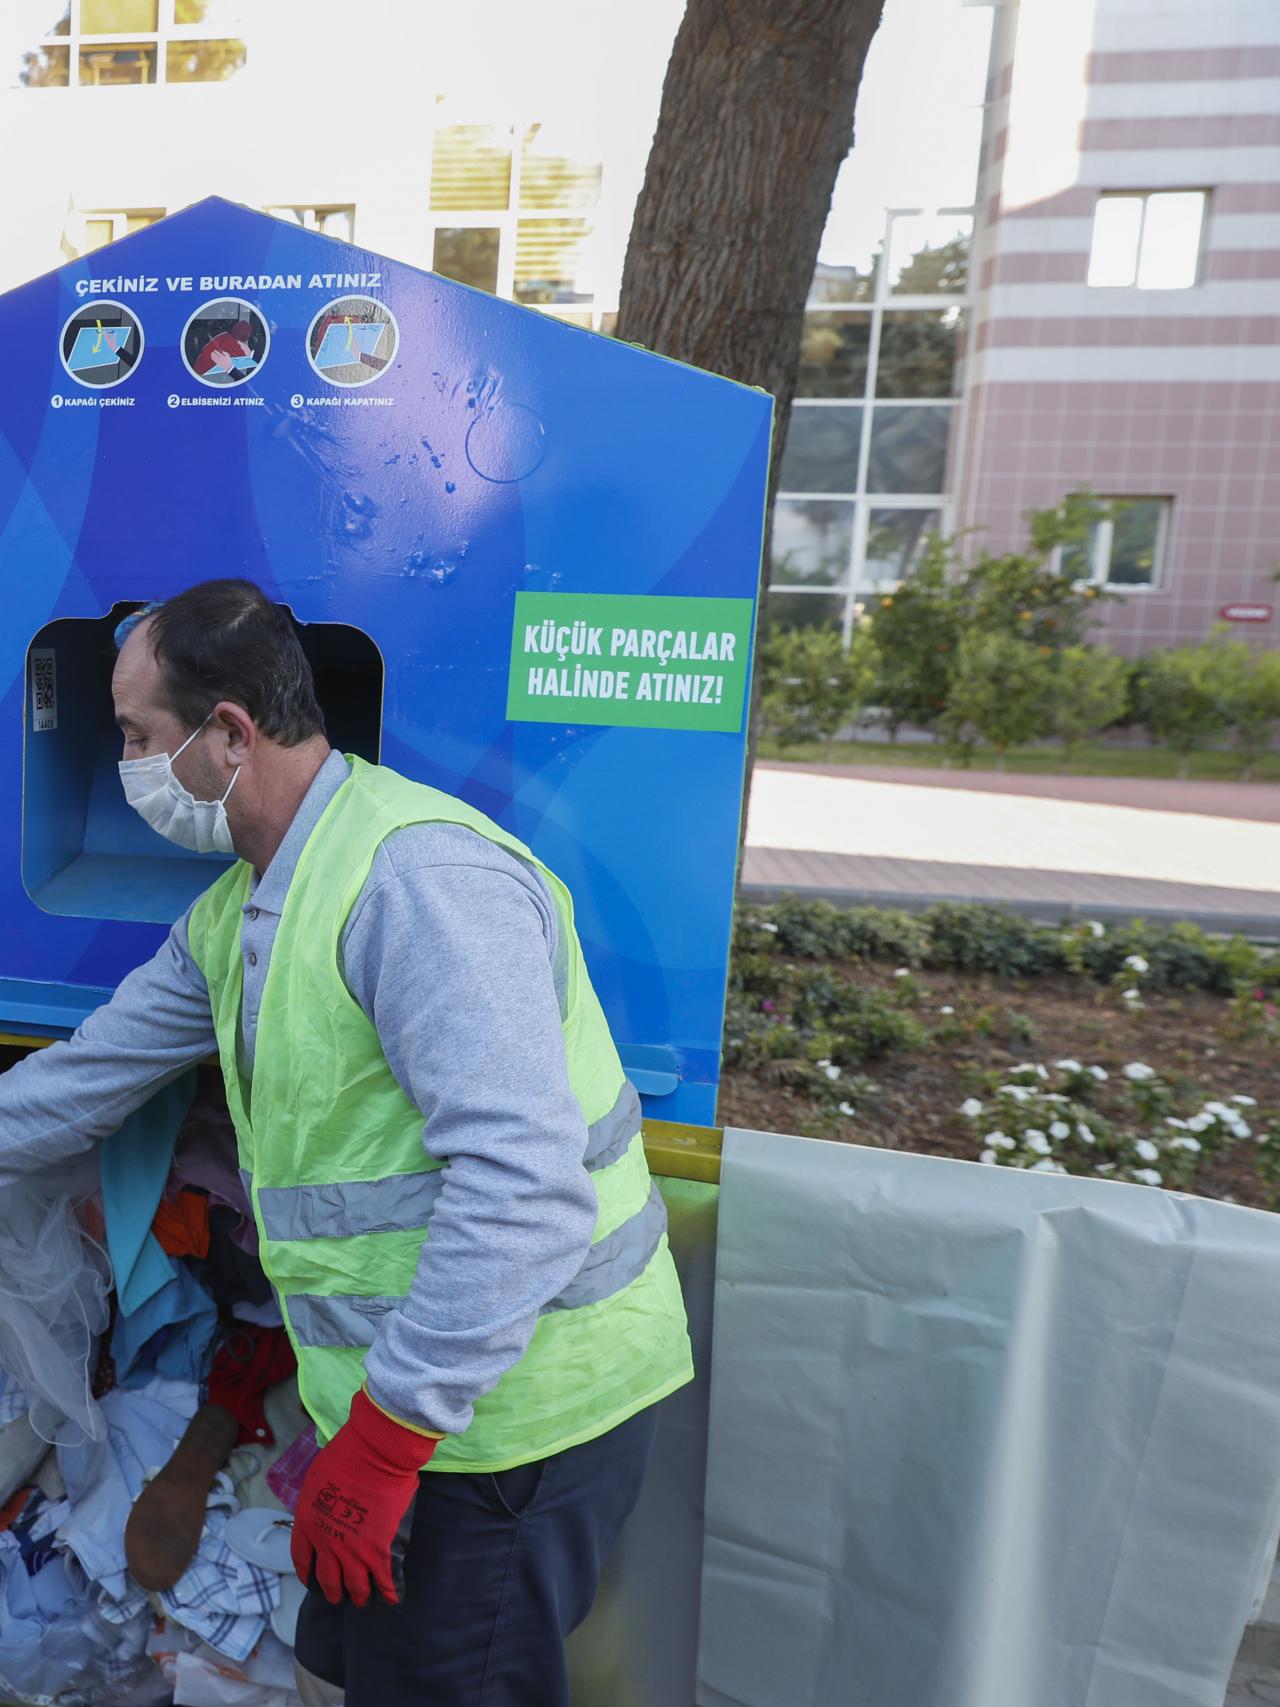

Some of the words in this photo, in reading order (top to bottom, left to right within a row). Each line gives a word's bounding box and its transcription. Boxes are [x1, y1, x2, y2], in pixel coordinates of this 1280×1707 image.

[75, 276, 158, 297] ÇEKİNİZ
[166, 277, 193, 291] VE
[199, 275, 302, 291] BURADAN
[308, 273, 382, 289] ATINIZ
[64, 397, 97, 406] KAPAĞI
[99, 397, 135, 408] ÇEKİNİZ
[181, 396, 231, 406] ELBİSENİZİ
[233, 398, 265, 406] ATINIZ
[306, 397, 341, 406] KAPAĞI
[344, 397, 395, 406] KAPATINIZ
[523, 619, 603, 661] KÜÇÜK
[610, 628, 736, 666] PARÇALAR
[527, 663, 630, 700] HALİNDE
[635, 672, 724, 704] ATINIZ!
